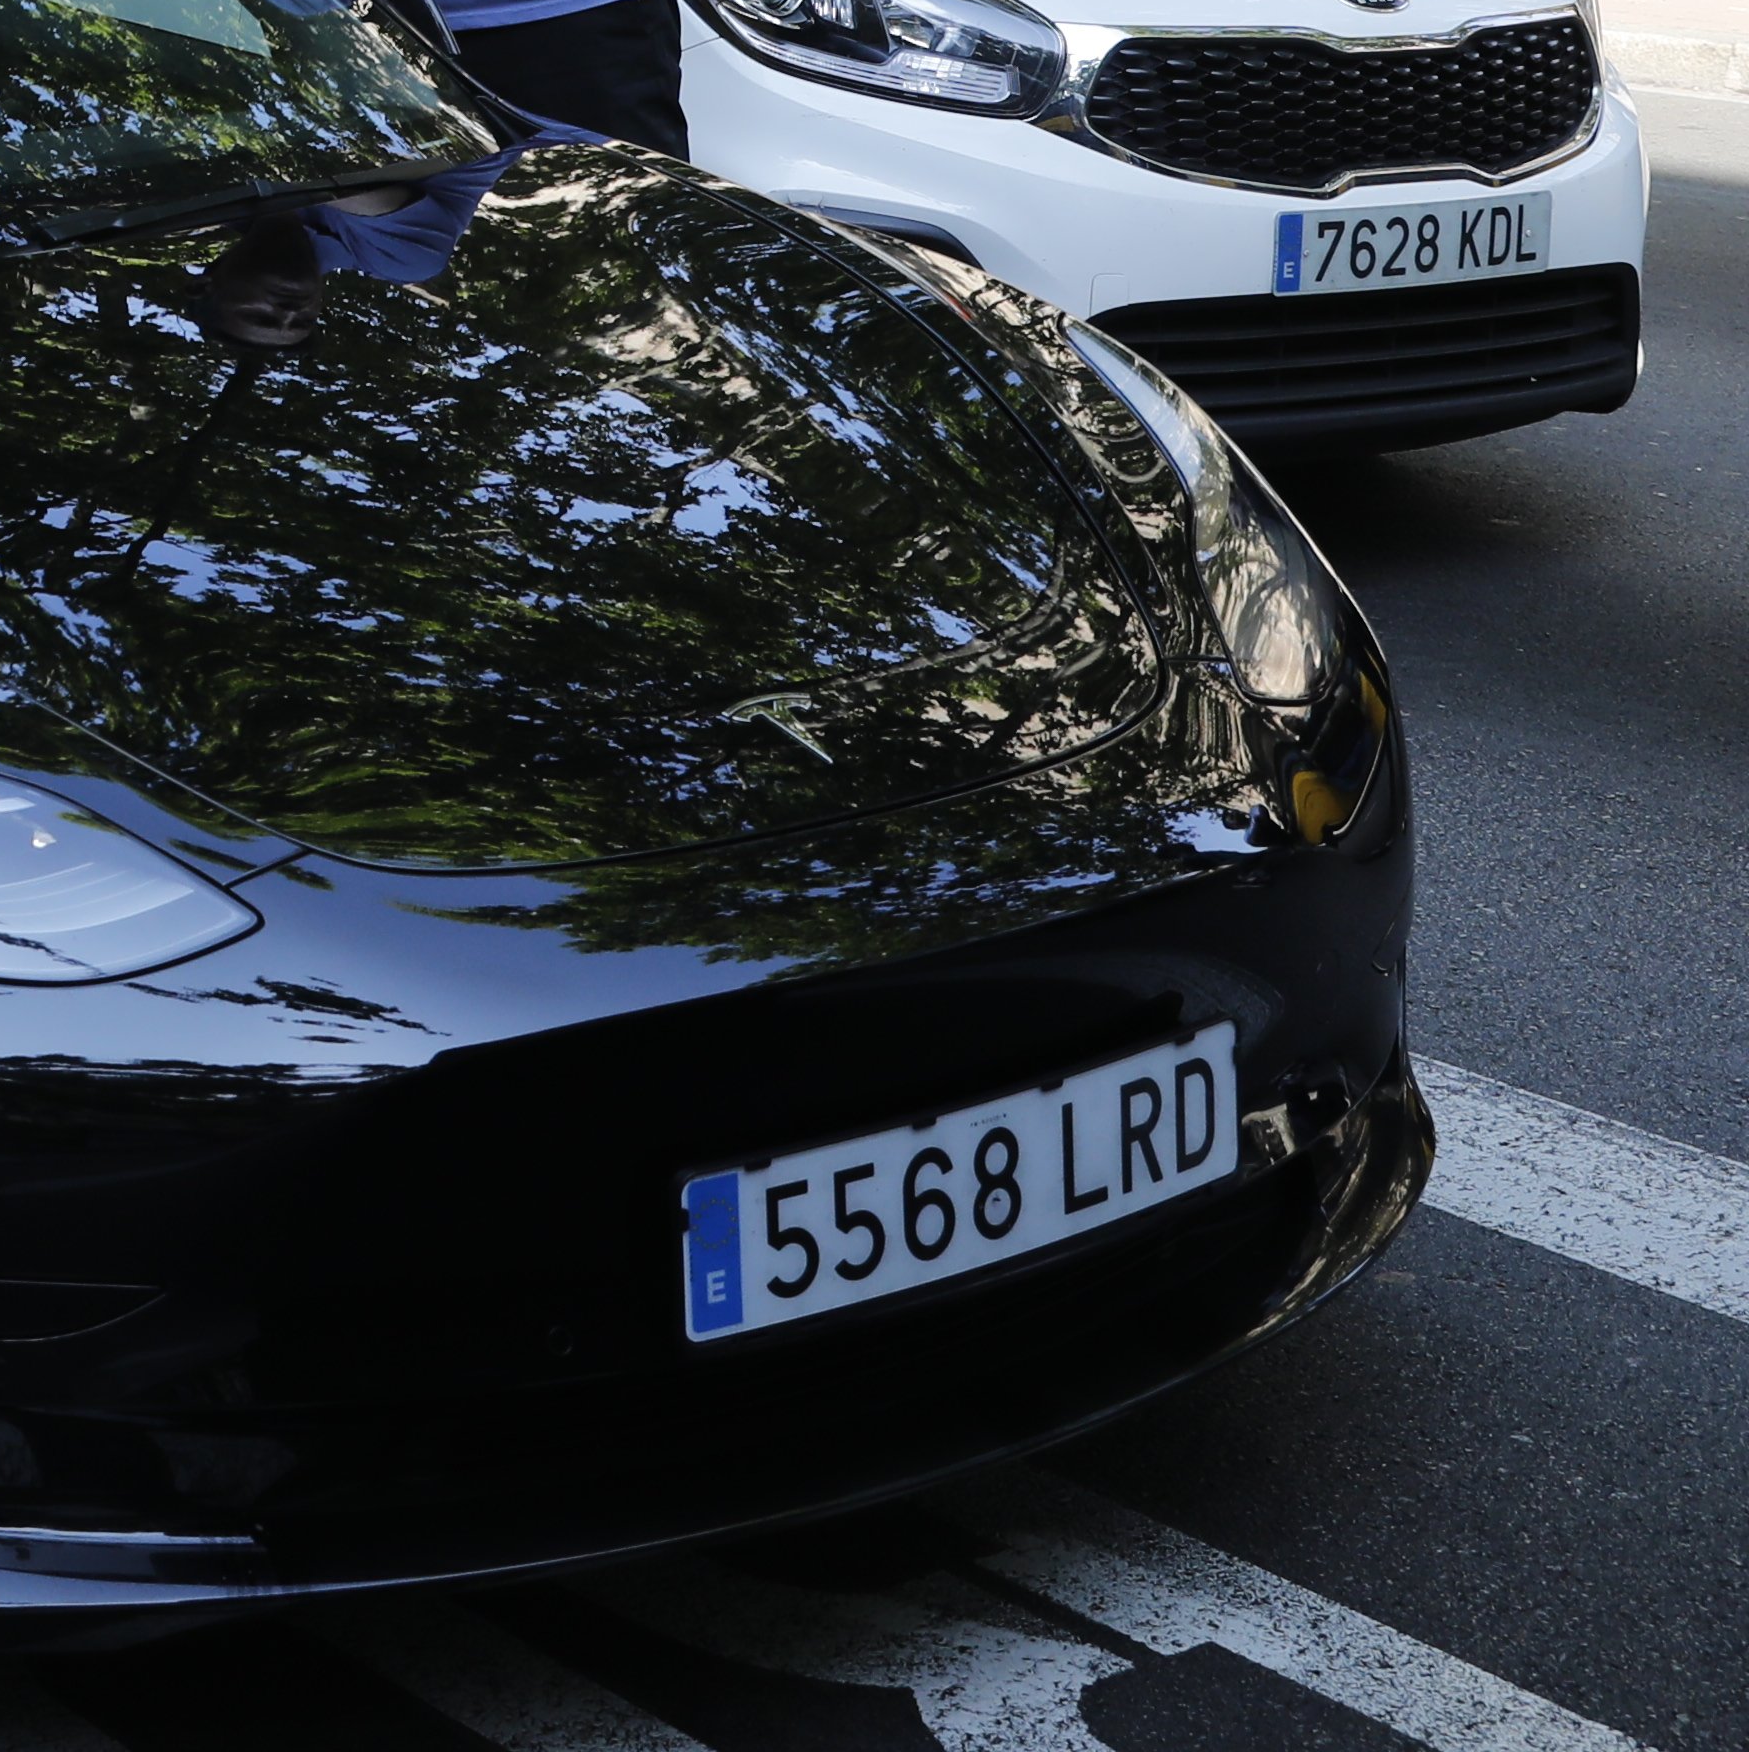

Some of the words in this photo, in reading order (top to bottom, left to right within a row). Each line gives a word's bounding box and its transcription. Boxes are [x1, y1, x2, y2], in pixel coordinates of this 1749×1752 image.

[1283, 260, 1295, 280] E
[1314, 214, 1441, 283] 7628
[1458, 203, 1537, 270] KDL
[706, 1268, 727, 1305] E
[765, 1125, 1023, 1300] 5568
[1061, 1056, 1216, 1216] LRD
